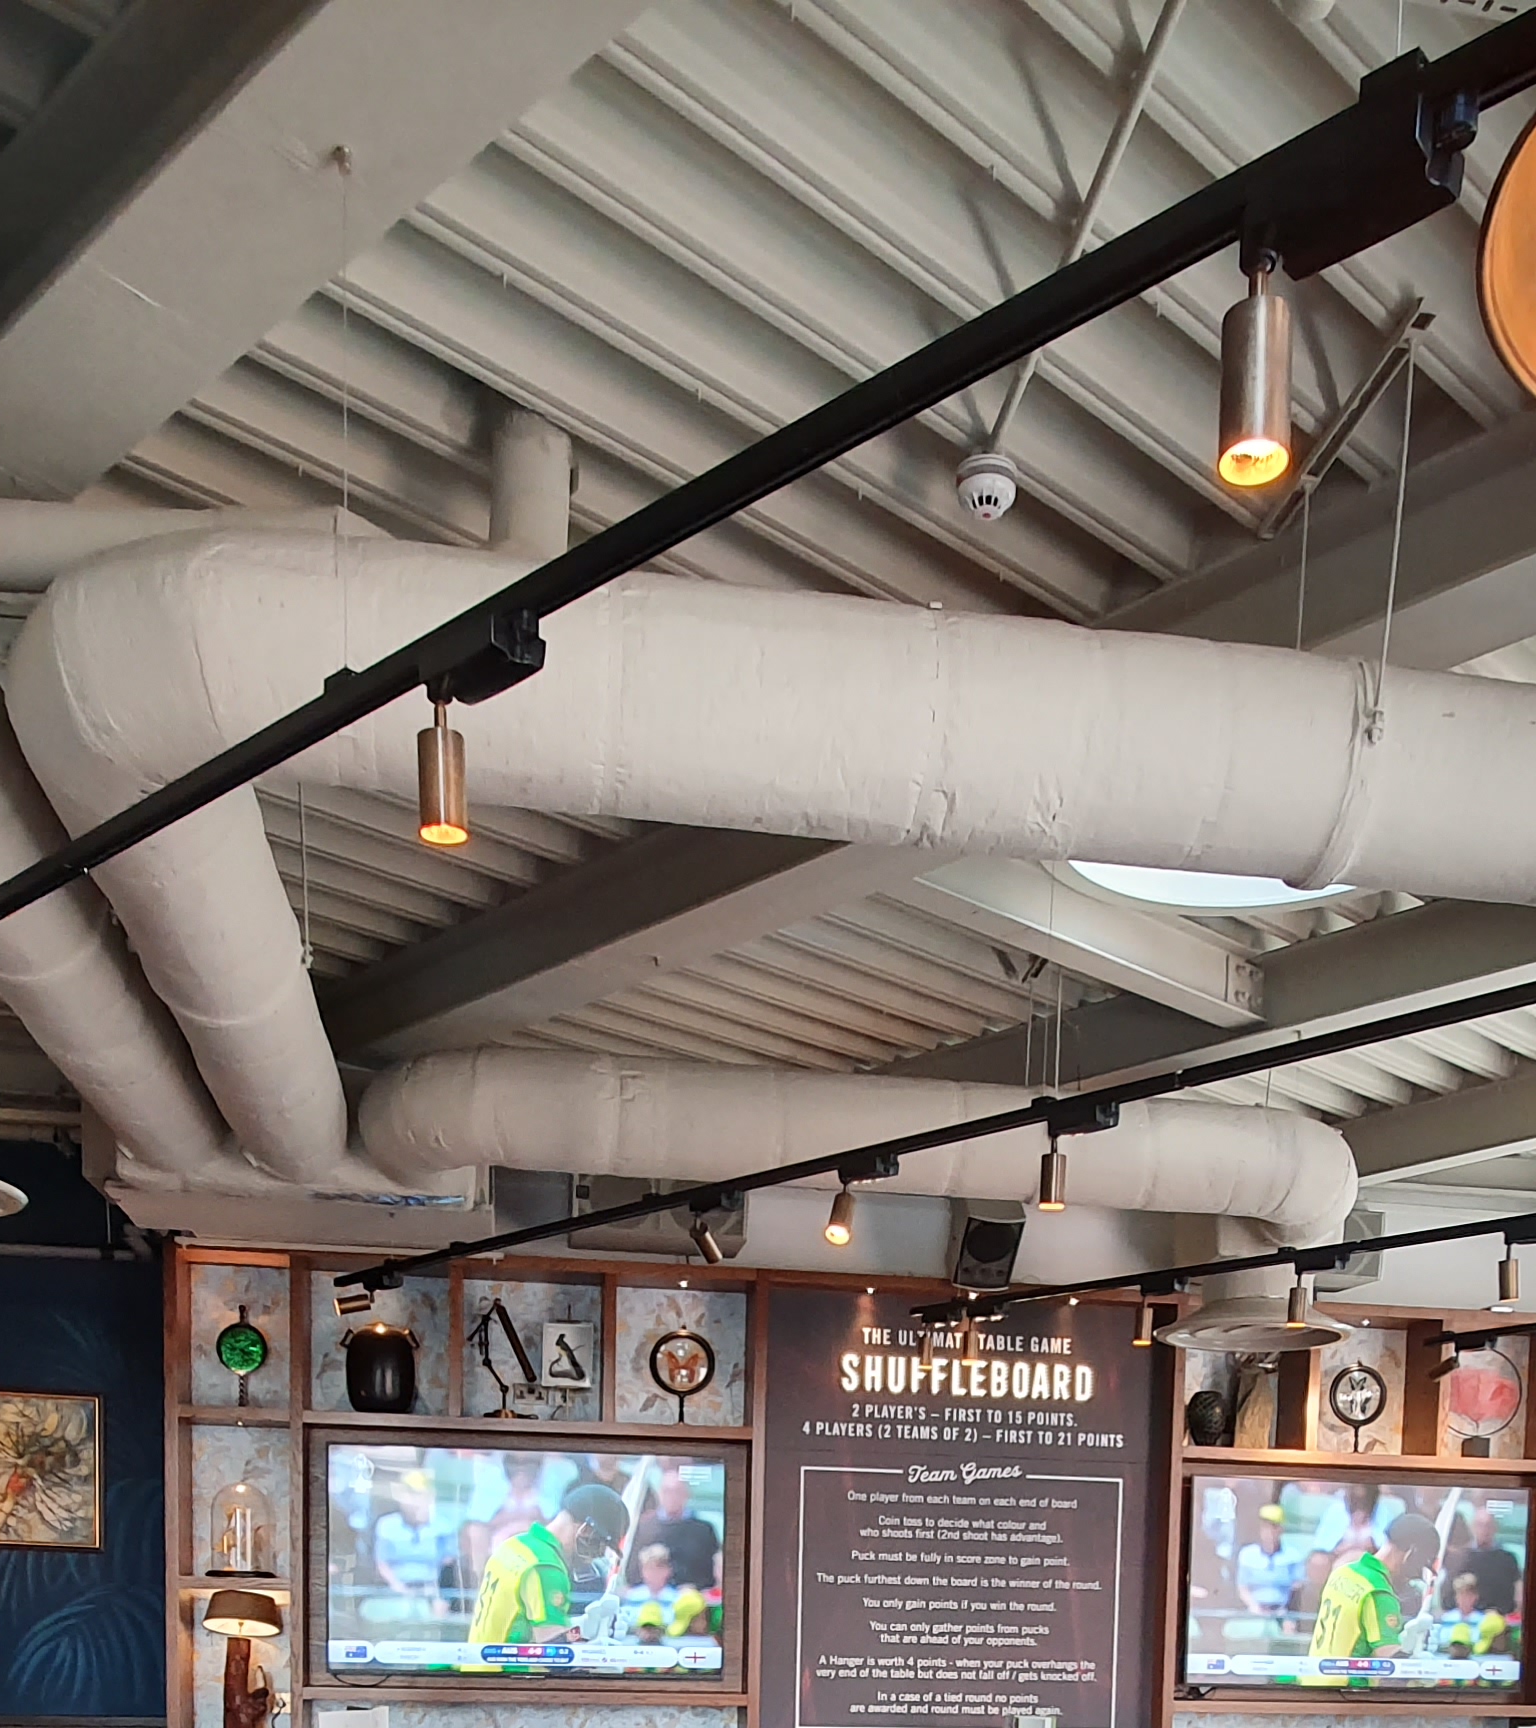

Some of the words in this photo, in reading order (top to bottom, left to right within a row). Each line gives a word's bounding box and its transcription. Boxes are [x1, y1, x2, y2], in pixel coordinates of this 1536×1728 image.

[862, 1327, 891, 1345] THE
[898, 1329, 964, 1350] ULMAT
[977, 1333, 1024, 1352] TABLE
[1030, 1336, 1072, 1355] GAME
[841, 1352, 1093, 1402] SHUFFLEBOARD
[852, 1404, 860, 1418] 2
[864, 1404, 926, 1420] PLAYER'S
[944, 1408, 981, 1422] FIRST
[986, 1410, 1002, 1424] TO
[1008, 1410, 1022, 1424] 15
[1027, 1412, 1078, 1427] POINTS.
[802, 1420, 810, 1434] 4
[815, 1421, 872, 1437] PLAYERS
[877, 1423, 891, 1439] (2
[897, 1424, 938, 1440] TEAMS
[943, 1426, 959, 1440] OF
[964, 1427, 978, 1443] 2)
[995, 1428, 1032, 1444] FIRST
[1037, 1430, 1052, 1445] TO
[1057, 1431, 1071, 1445] 21
[1077, 1432, 1124, 1448] POINTS
[907, 1464, 957, 1483] Team
[959, 1462, 1023, 1485] Games
[846, 1489, 867, 1501] One
[869, 1491, 899, 1504] player
[901, 1492, 924, 1503] from
[926, 1494, 950, 1504] each
[952, 1494, 976, 1504] team
[978, 1497, 991, 1505] on
[992, 1496, 1016, 1506] each
[1018, 1497, 1036, 1507] end
[1038, 1497, 1049, 1507] of
[1050, 1498, 1077, 1509] board
[878, 1515, 900, 1525] Coin
[902, 1516, 923, 1526] toss
[924, 1517, 935, 1527] to
[936, 1517, 969, 1528] decide
[971, 1518, 994, 1529] what
[996, 1519, 1026, 1530] colour
[1028, 1520, 1047, 1530] and
[859, 1527, 880, 1537] who
[881, 1527, 913, 1538] shoots
[914, 1528, 934, 1539] first
[936, 1529, 960, 1540] (2nd
[962, 1530, 988, 1541] shoot
[990, 1531, 1008, 1541] has
[1009, 1532, 1063, 1545] advantage).
[851, 1549, 876, 1560] Puck
[878, 1551, 902, 1561] must
[905, 1551, 917, 1561] be
[920, 1551, 942, 1564] fully
[943, 1554, 954, 1562] in
[956, 1555, 982, 1564] score
[983, 1555, 1006, 1564] zone
[1008, 1555, 1018, 1564] to
[1019, 1556, 1040, 1567] gain
[1043, 1556, 1070, 1567] point.
[816, 1572, 834, 1583] The
[836, 1573, 861, 1585] puck
[863, 1573, 901, 1584] furthest
[903, 1574, 929, 1585] down
[932, 1576, 948, 1586] the
[950, 1576, 978, 1587] board
[980, 1578, 989, 1587] is
[990, 1577, 1006, 1587] the
[1008, 1580, 1041, 1588] winner
[1041, 1578, 1053, 1588] of
[1054, 1579, 1070, 1589] the
[1071, 1580, 1102, 1590] round.
[862, 1597, 880, 1607] You
[882, 1597, 903, 1610] only
[904, 1599, 926, 1610] gain
[928, 1598, 958, 1610] points
[960, 1599, 968, 1609] if
[970, 1602, 987, 1612] you
[989, 1601, 1006, 1610] win
[1008, 1601, 1025, 1611] the
[1026, 1601, 1056, 1611] round.
[869, 1620, 887, 1630] You
[889, 1622, 907, 1631] can
[909, 1621, 930, 1634] only
[932, 1622, 963, 1634] gather
[964, 1623, 995, 1634] points
[996, 1623, 1019, 1633] from
[1021, 1624, 1049, 1636] pucks
[880, 1632, 900, 1643] that
[902, 1635, 918, 1643] are
[919, 1633, 949, 1644] ahead
[950, 1634, 962, 1644] of
[962, 1636, 984, 1646] your
[985, 1636, 1038, 1647] opponents.
[818, 1654, 827, 1665] A
[829, 1654, 864, 1667] Hanger
[866, 1657, 875, 1666] is
[877, 1655, 904, 1666] worth
[906, 1655, 914, 1666] 4
[916, 1656, 947, 1668] points
[954, 1657, 981, 1667] when
[982, 1660, 1004, 1670] your
[1005, 1658, 1029, 1670] puck
[1031, 1659, 1078, 1671] overhangs
[1079, 1660, 1096, 1670] the
[815, 1669, 836, 1679] very
[838, 1667, 857, 1677] end
[858, 1667, 869, 1677] of
[871, 1668, 888, 1678] the
[890, 1668, 915, 1678] table
[917, 1668, 933, 1679] but
[935, 1668, 958, 1679] does
[960, 1669, 976, 1680] not
[978, 1669, 994, 1680] fall
[996, 1669, 1010, 1680] off
[1017, 1670, 1038, 1682] gets
[1040, 1670, 1081, 1681] knocked
[1080, 1671, 1097, 1682] off.
[877, 1690, 888, 1701] In
[889, 1693, 896, 1701] a
[898, 1693, 920, 1701] case
[922, 1691, 933, 1702] of
[934, 1693, 942, 1702] a
[943, 1692, 963, 1702] tied
[964, 1692, 993, 1703] round
[994, 1694, 1007, 1702] no
[1008, 1693, 1038, 1705] points
[849, 1704, 866, 1712] are
[867, 1703, 908, 1713] awarded
[910, 1703, 928, 1714] and
[930, 1703, 959, 1714] round
[960, 1704, 985, 1714] must
[987, 1704, 1000, 1714] be
[1001, 1705, 1032, 1717] played
[1034, 1707, 1063, 1716] again.
